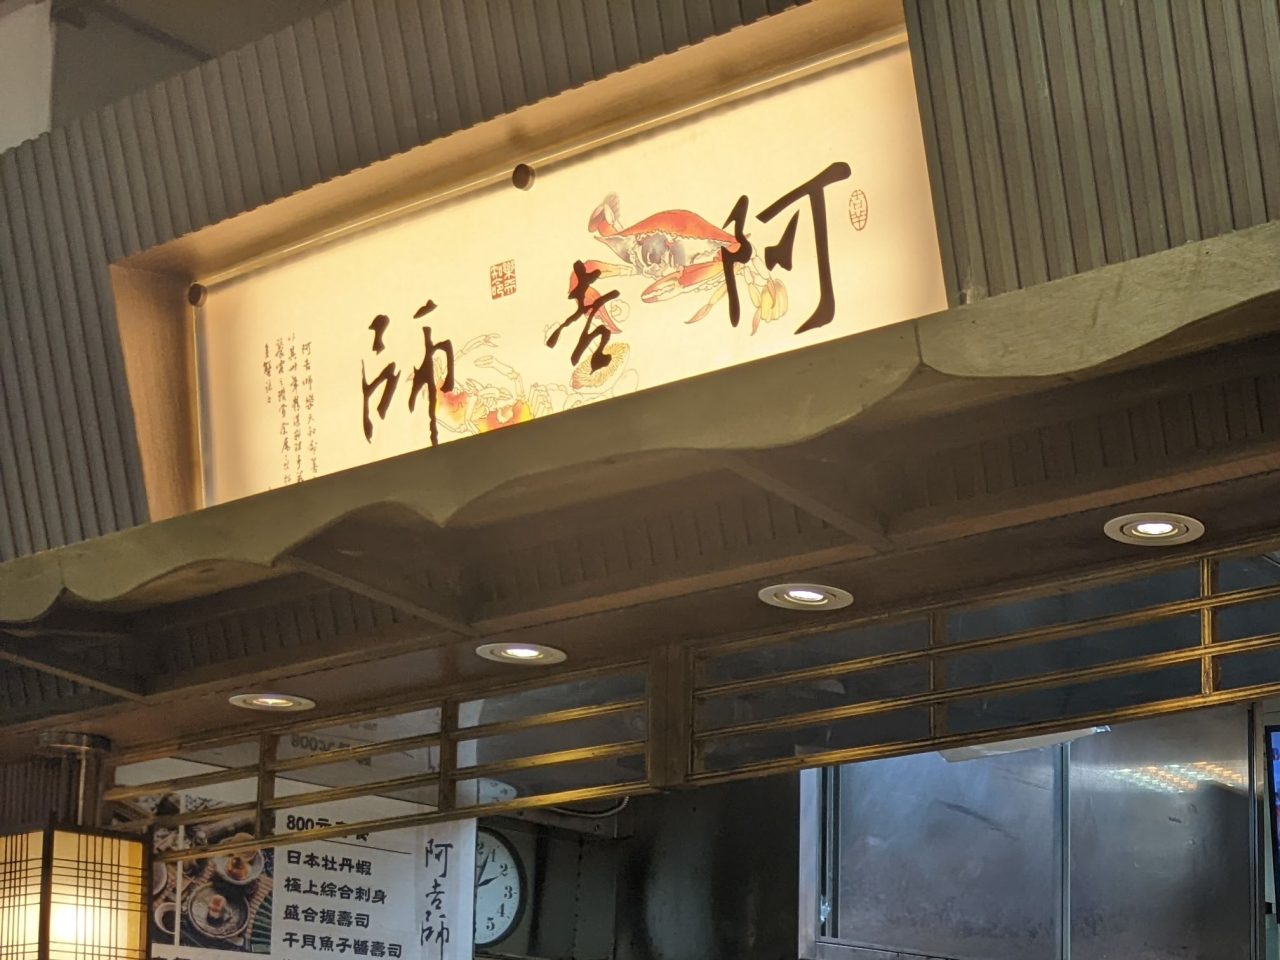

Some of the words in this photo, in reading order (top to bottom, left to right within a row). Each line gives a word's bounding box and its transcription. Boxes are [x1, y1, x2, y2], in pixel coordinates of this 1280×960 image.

[361, 161, 852, 446] 阿吉師
[287, 850, 372, 876] 日本牡丹蝦
[284, 877, 388, 904] 極上綜合刺身
[283, 904, 370, 929] 盛合握壽司
[282, 932, 402, 959] 干貝魚子醬壽司
